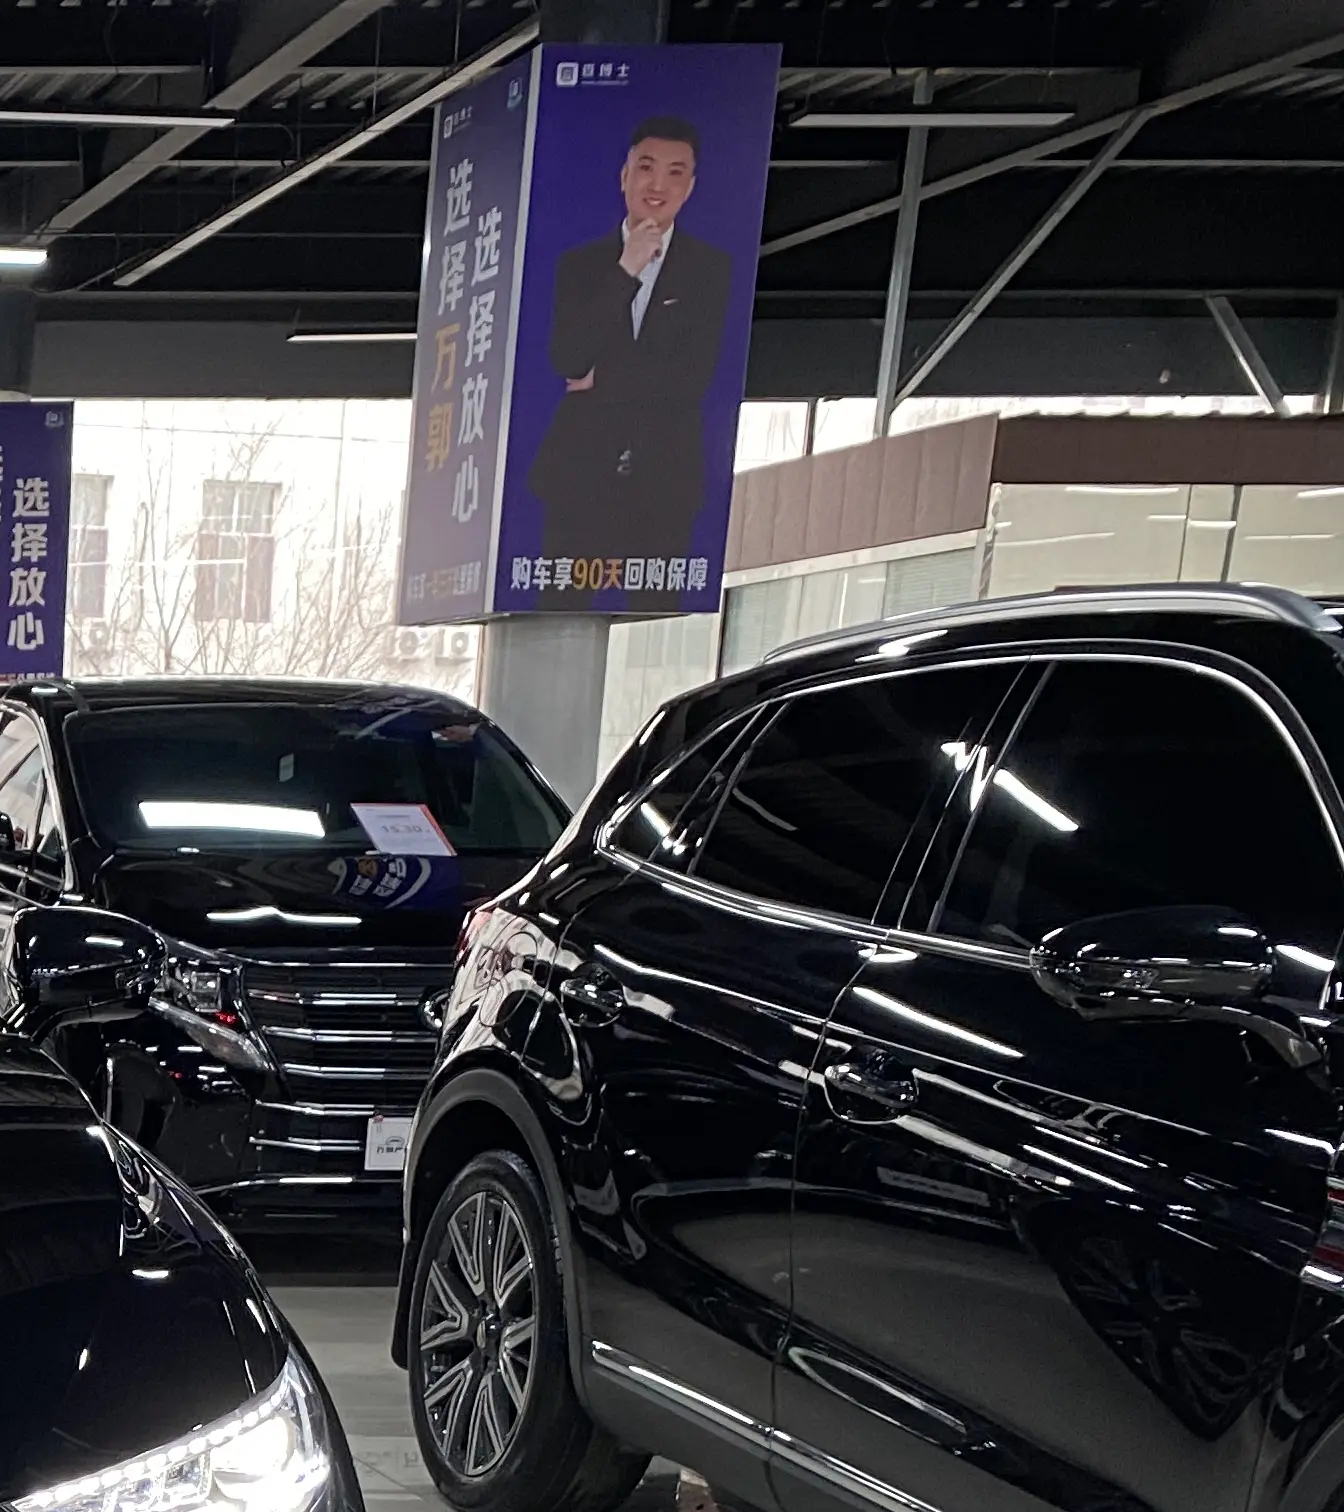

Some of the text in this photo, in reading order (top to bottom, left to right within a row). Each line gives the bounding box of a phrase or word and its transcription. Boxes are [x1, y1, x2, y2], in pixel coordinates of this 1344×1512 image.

[424, 157, 474, 473] 选择万郭
[451, 205, 503, 524] 选择放心
[6, 476, 50, 651] 选择放心
[510, 556, 709, 592] 购车享90天回购保障
